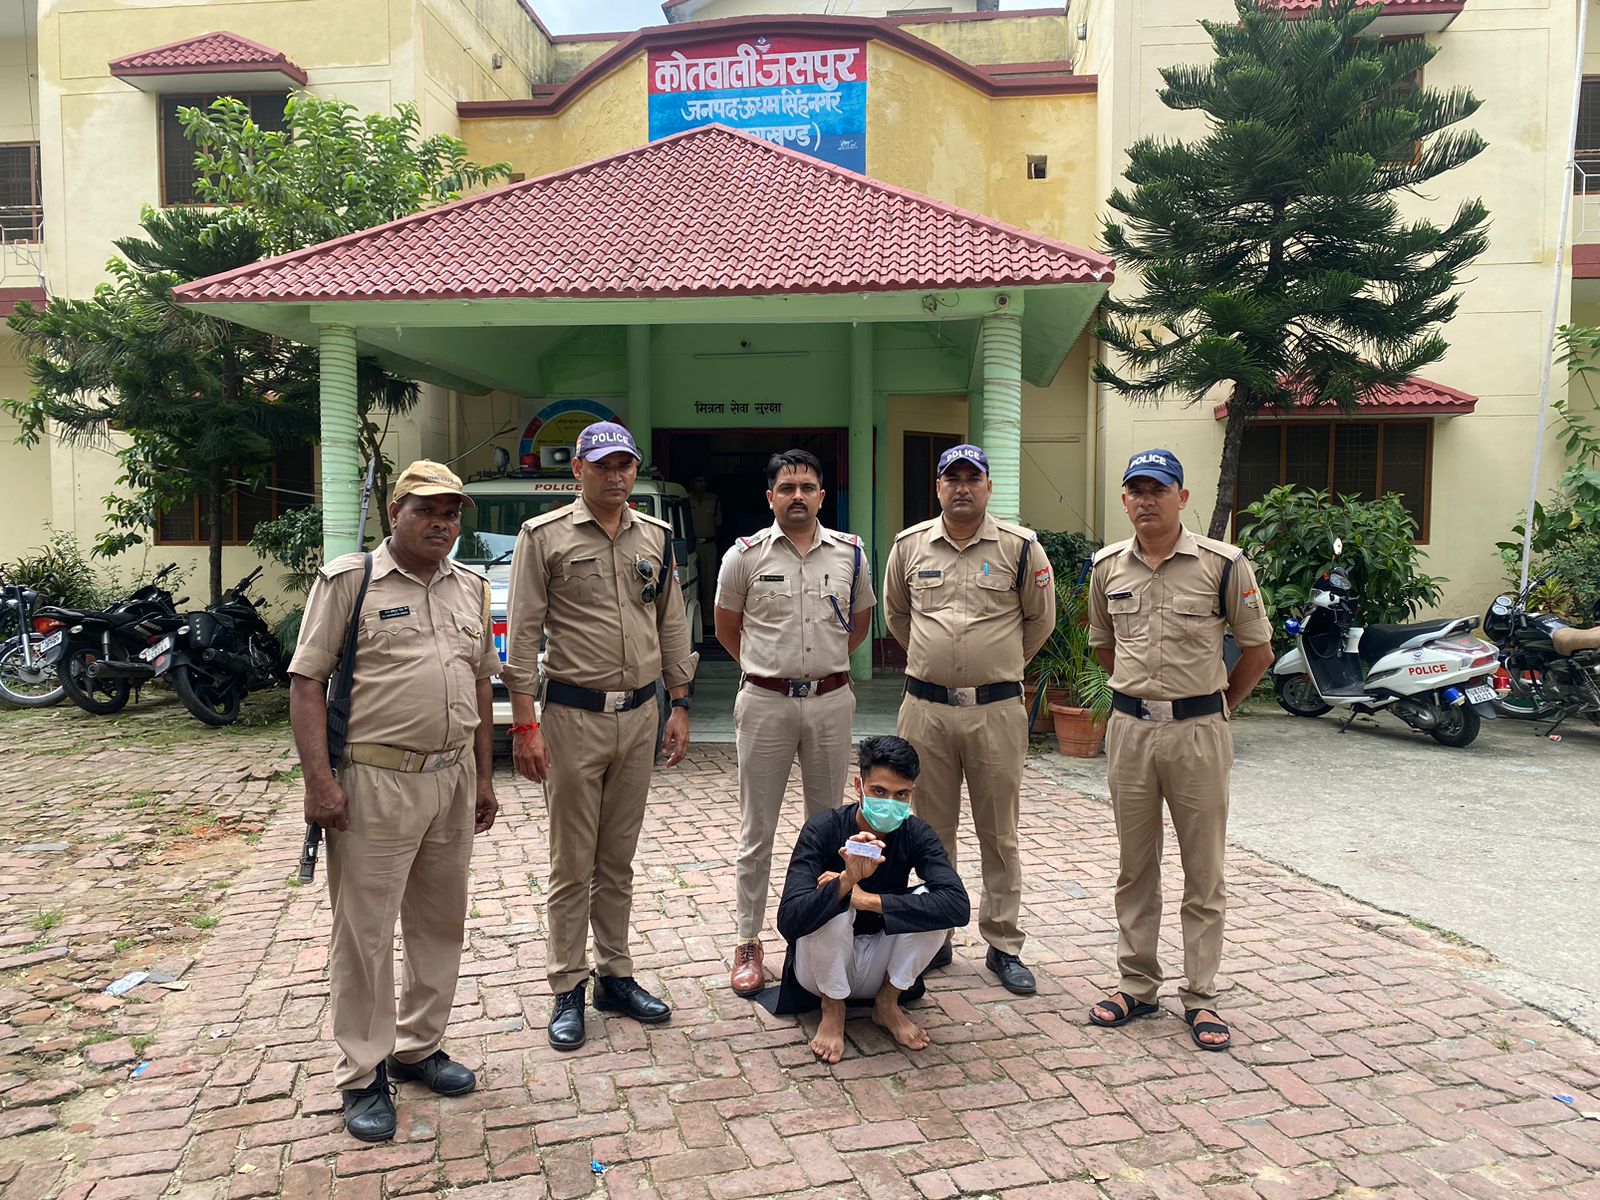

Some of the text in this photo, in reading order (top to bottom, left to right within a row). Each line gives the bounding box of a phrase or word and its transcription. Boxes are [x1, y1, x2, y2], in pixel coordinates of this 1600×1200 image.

[655, 44, 860, 92] कोतवाली जसपुर
[694, 400, 782, 415] मित्रता सेवा सुरक्षा
[591, 432, 631, 446] POLICE
[947, 449, 981, 464] POLICE
[1129, 454, 1167, 469] POLICE
[1408, 664, 1448, 675] POLICE
